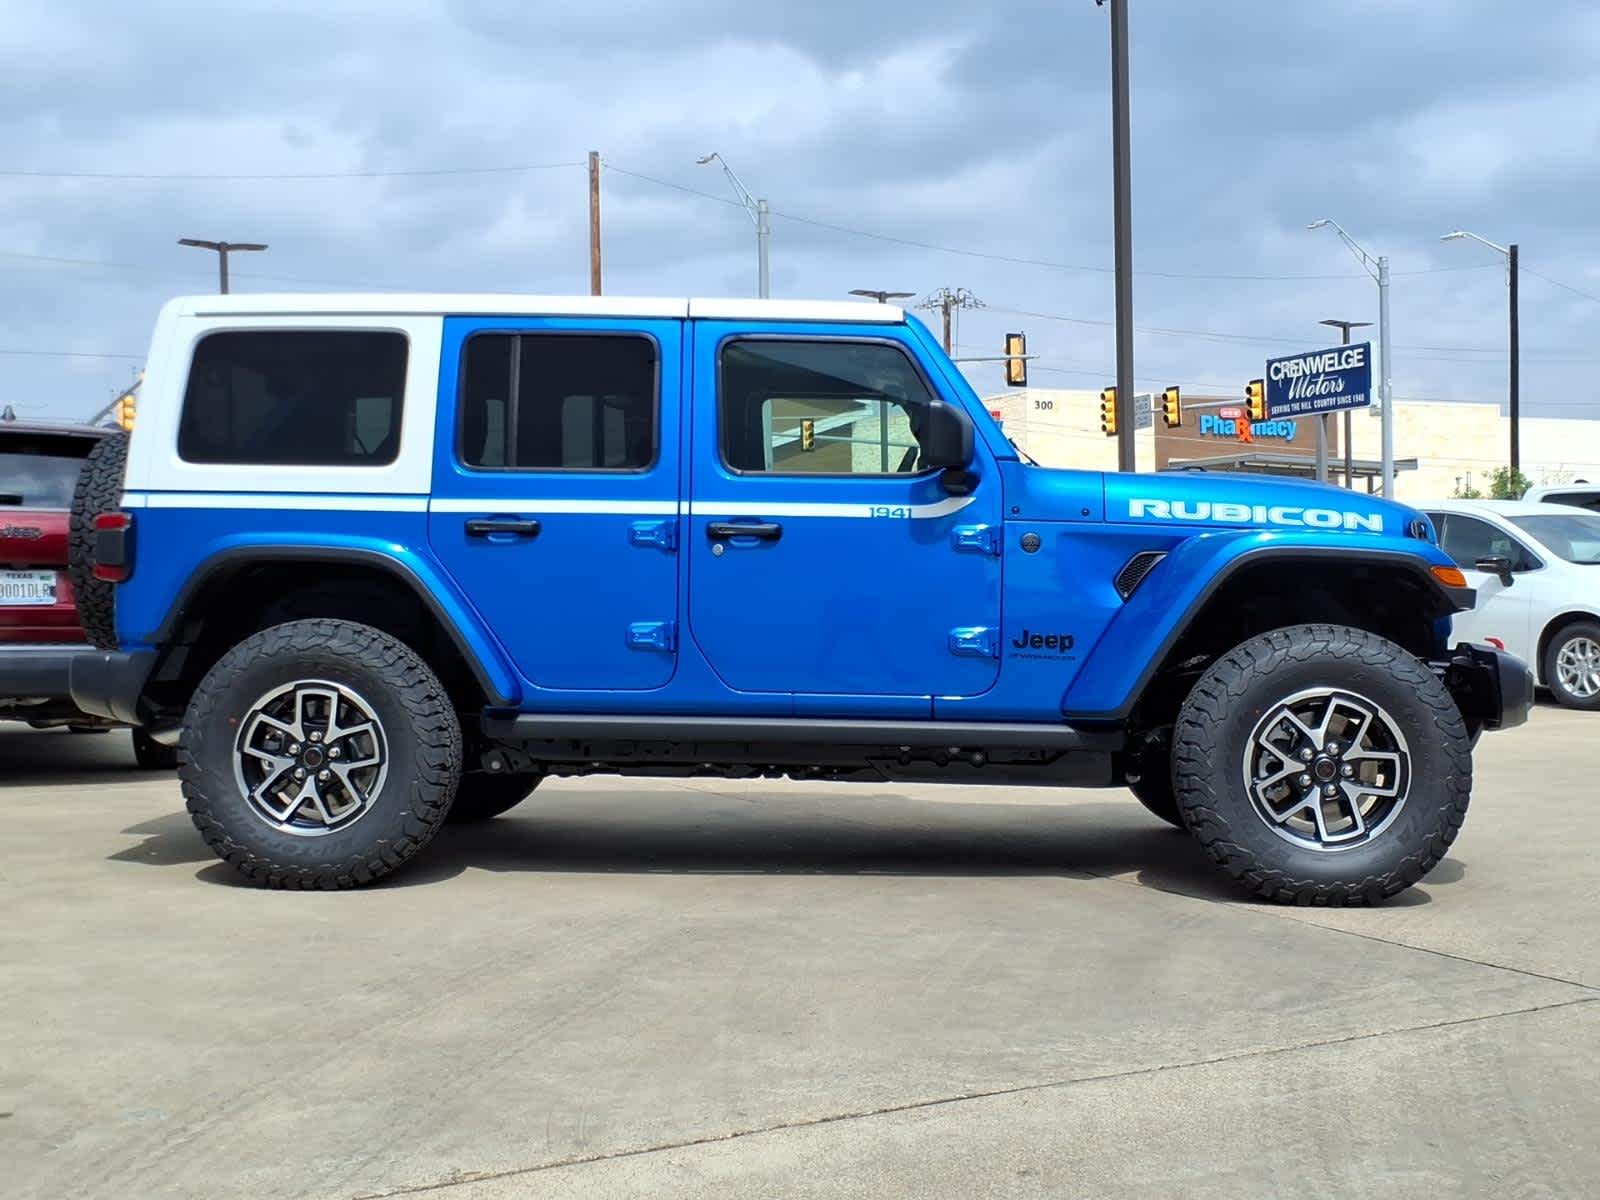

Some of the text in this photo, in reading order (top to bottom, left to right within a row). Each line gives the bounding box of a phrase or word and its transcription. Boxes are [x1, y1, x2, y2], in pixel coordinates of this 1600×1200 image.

[1270, 348, 1365, 380] CRENWELGE
[1288, 374, 1345, 400] Motors
[1035, 400, 1053, 410] 300
[1271, 404, 1291, 415] SERVING
[1291, 402, 1300, 412] THE
[1301, 400, 1312, 411] HILL
[1313, 397, 1336, 409] COUNTRY
[1337, 394, 1352, 406] SINCE
[868, 506, 912, 519] 1941
[1128, 498, 1384, 532] RUBICON
[1012, 629, 1074, 653] Jeep
